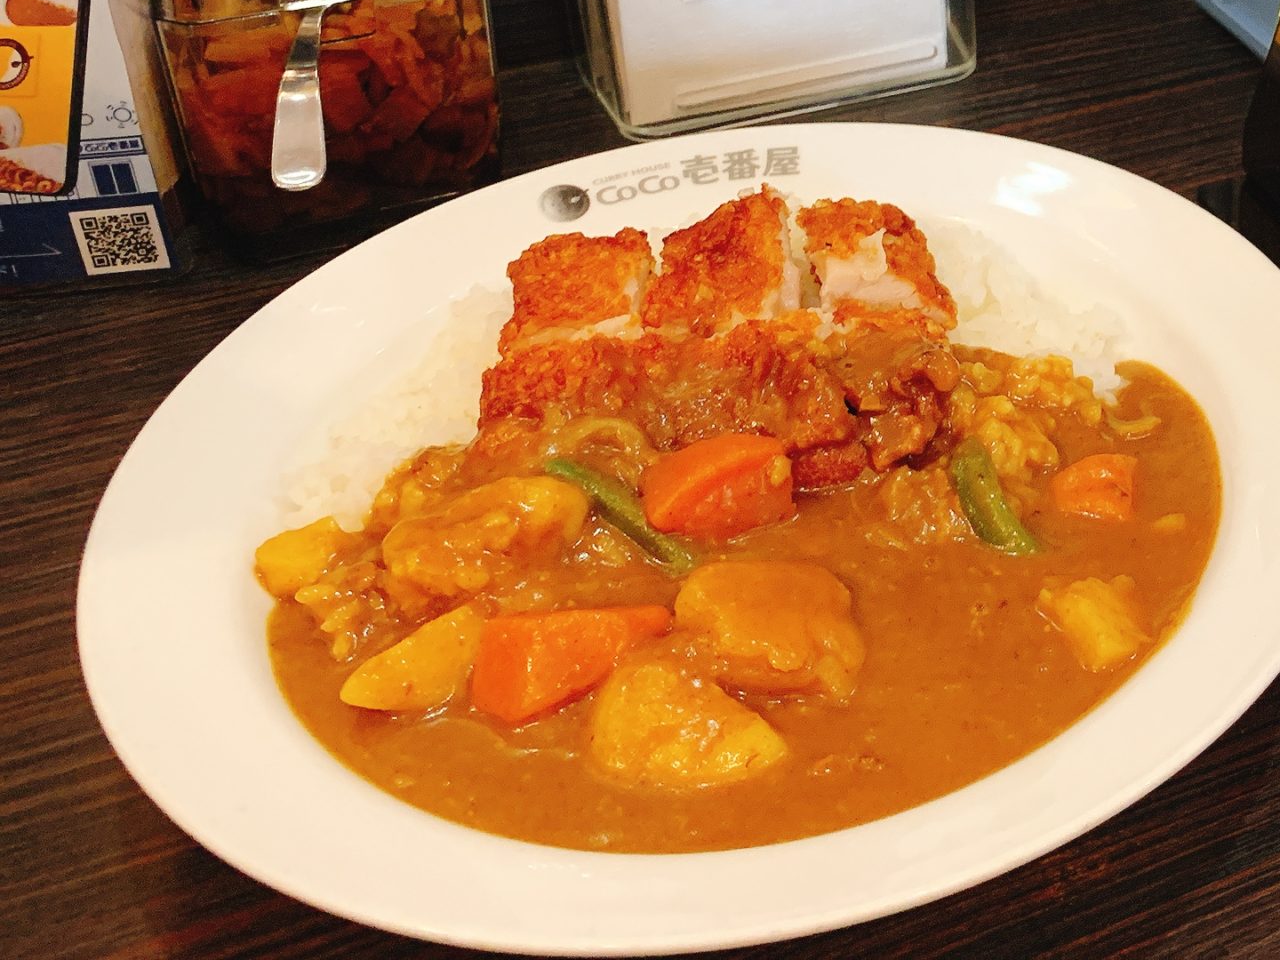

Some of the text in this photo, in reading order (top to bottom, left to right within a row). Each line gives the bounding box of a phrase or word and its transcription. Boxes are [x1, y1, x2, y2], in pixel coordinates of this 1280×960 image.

[592, 161, 672, 186] CURRY HOUSE
[596, 145, 801, 206] CoCo壱番屋
